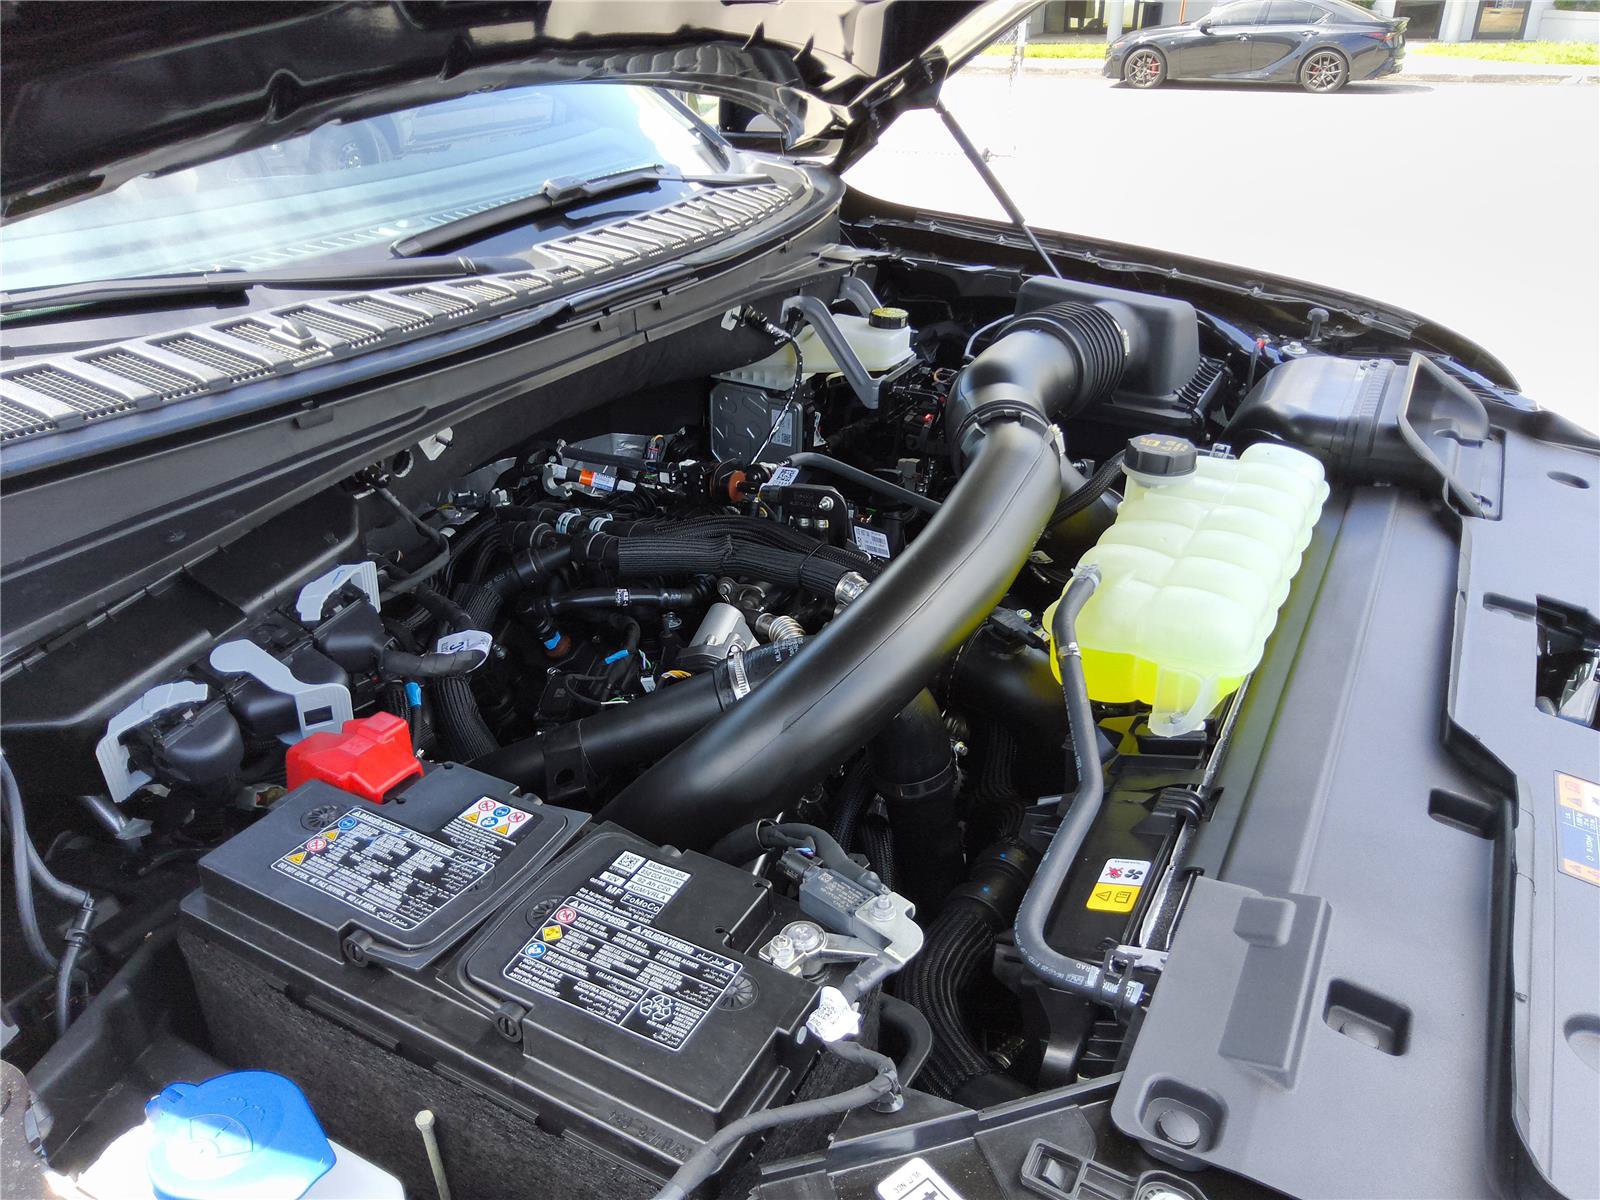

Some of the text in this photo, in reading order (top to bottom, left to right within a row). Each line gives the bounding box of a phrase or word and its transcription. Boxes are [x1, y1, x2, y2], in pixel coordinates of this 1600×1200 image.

[605, 885, 624, 895] MF
[629, 884, 665, 900] AGM/VRLA
[623, 894, 659, 912] FoMoCo
[578, 904, 629, 927] DANGER/POISON
[641, 929, 694, 954] PELIGRO/VENENO
[577, 981, 599, 993] CONTRA
